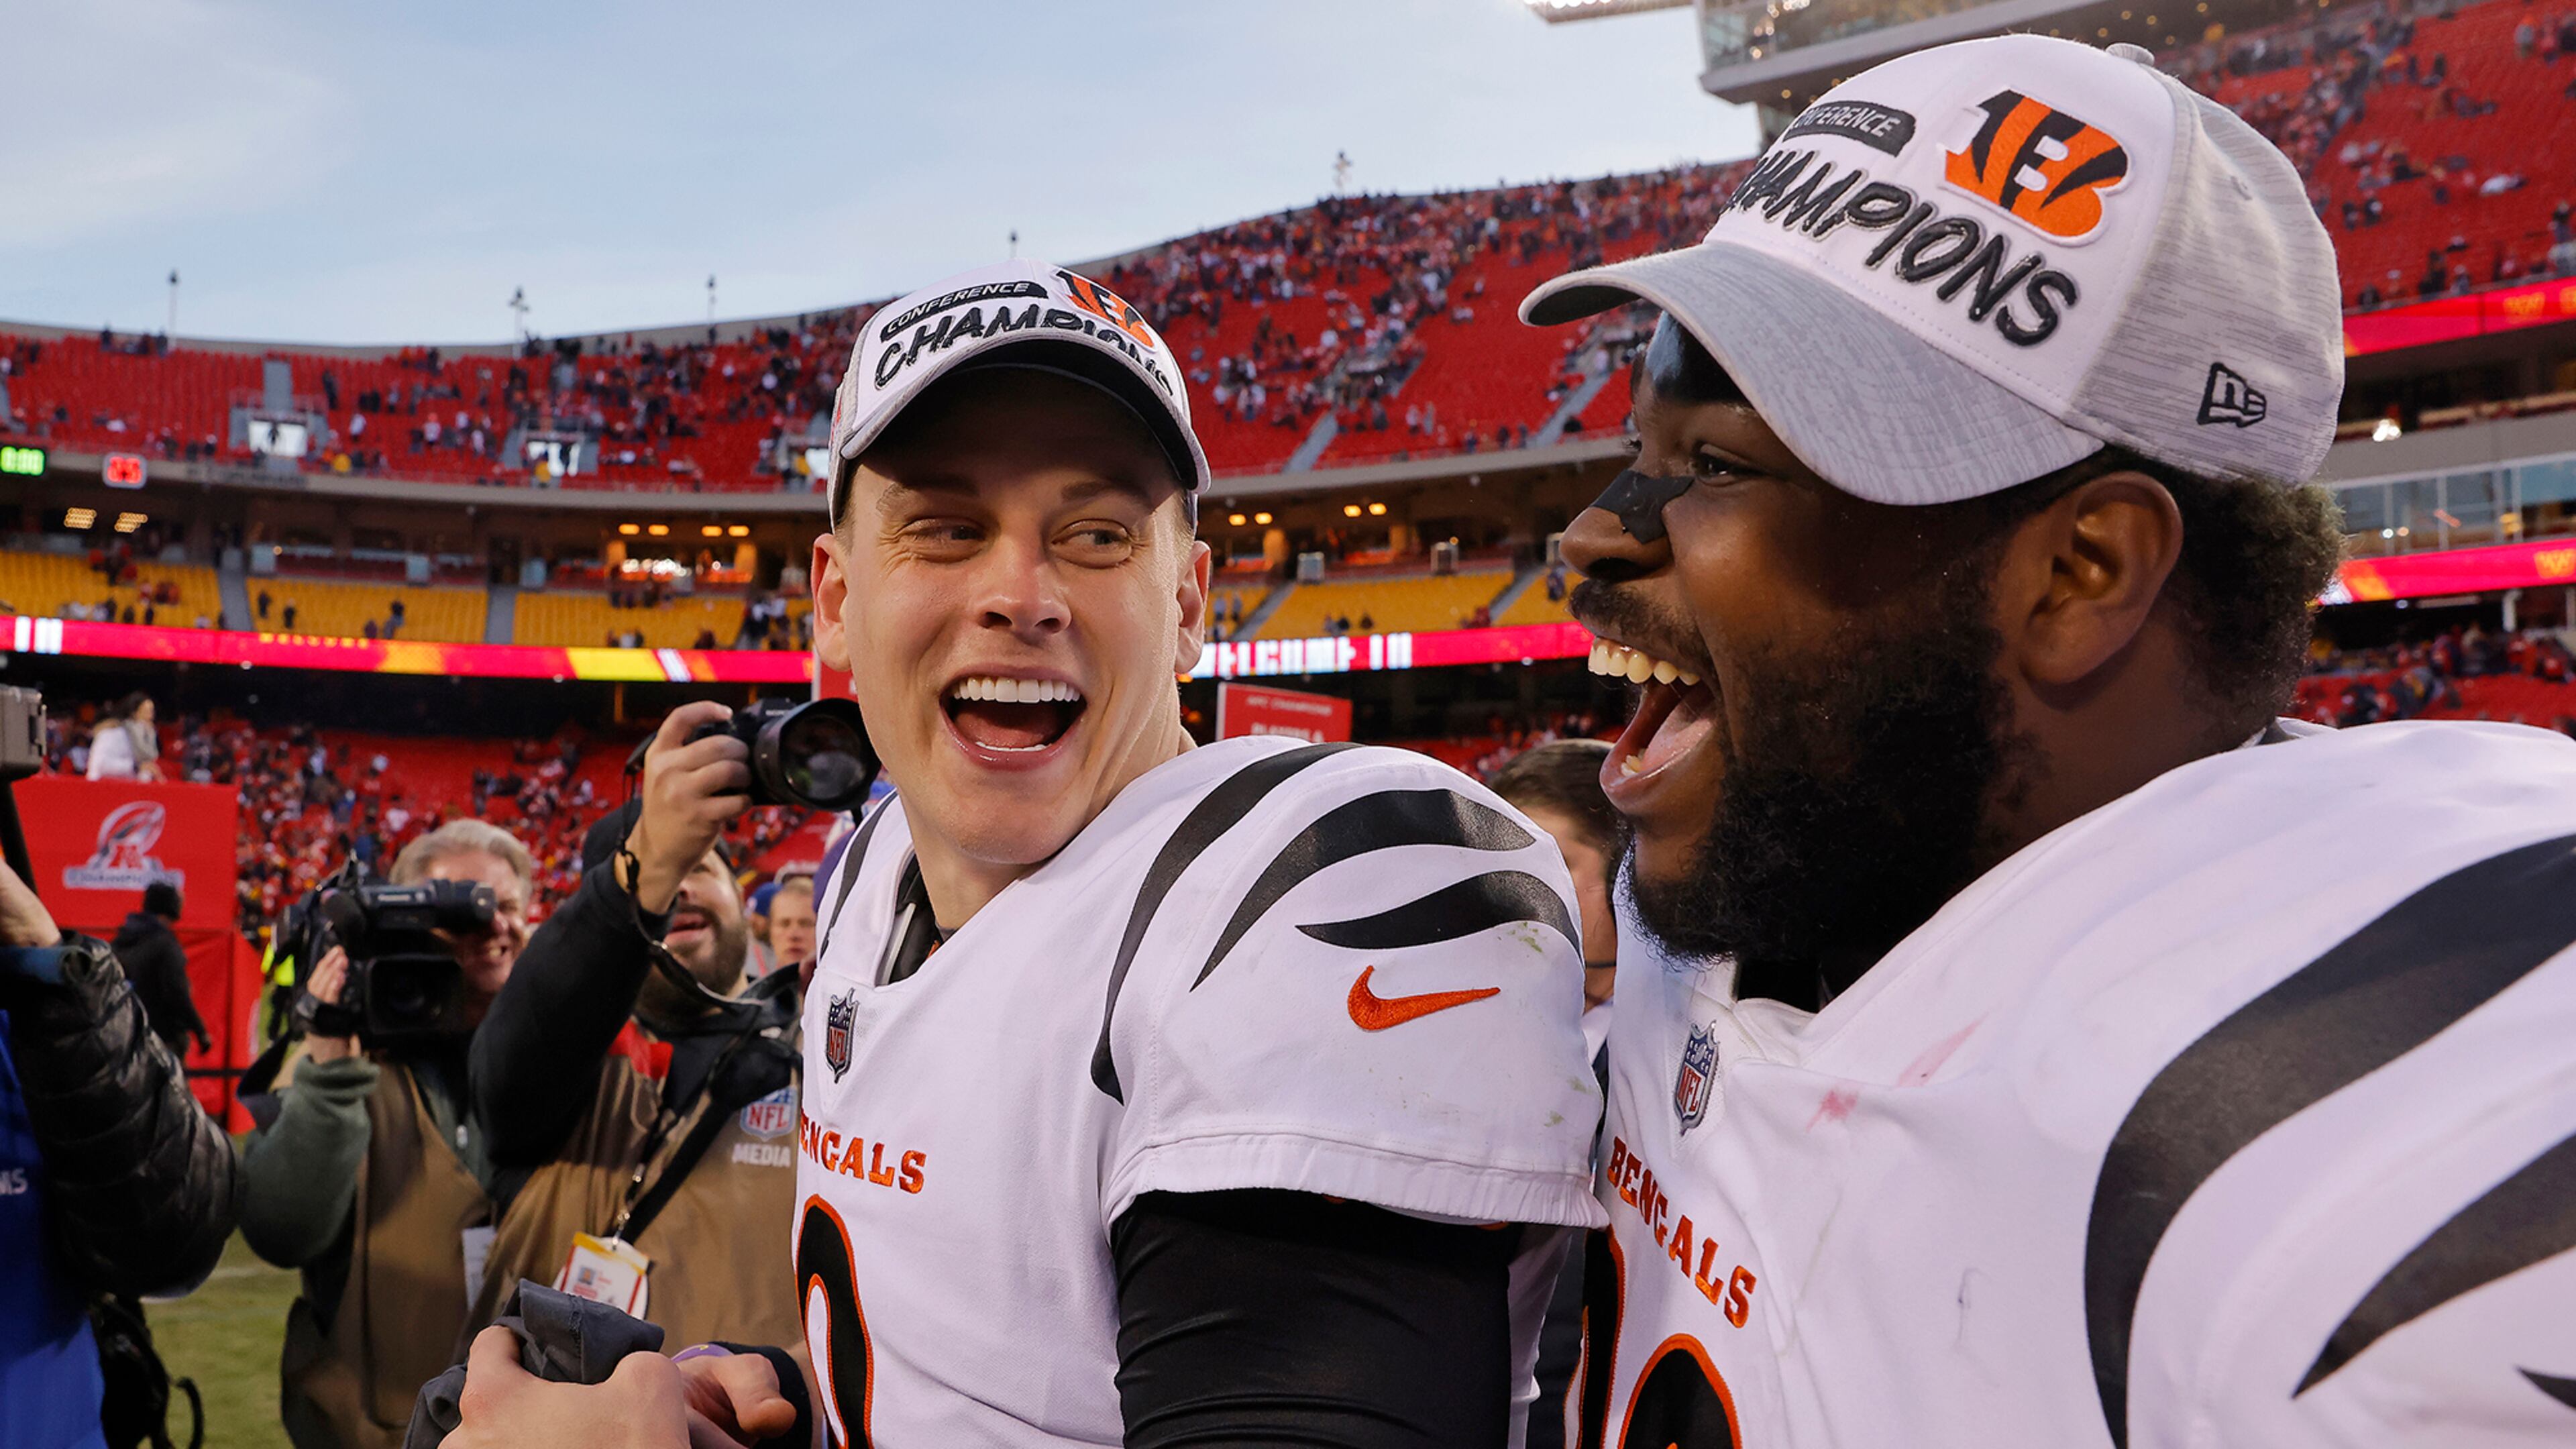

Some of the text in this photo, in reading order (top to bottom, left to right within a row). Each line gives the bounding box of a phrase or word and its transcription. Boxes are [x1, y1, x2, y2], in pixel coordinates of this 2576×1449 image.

[1792, 106, 1901, 138] NFERENCE
[1719, 149, 2079, 347] HAMPIONS
[887, 282, 1030, 333] CONFERENCE
[828, 1027, 847, 1065] NFL
[1677, 1063, 1703, 1114] NFL
[748, 1104, 789, 1130] NFL
[731, 1142, 791, 1167] MEDIA
[800, 1107, 926, 1194] ENGALS
[1607, 1136, 1757, 1328] BENGALS
